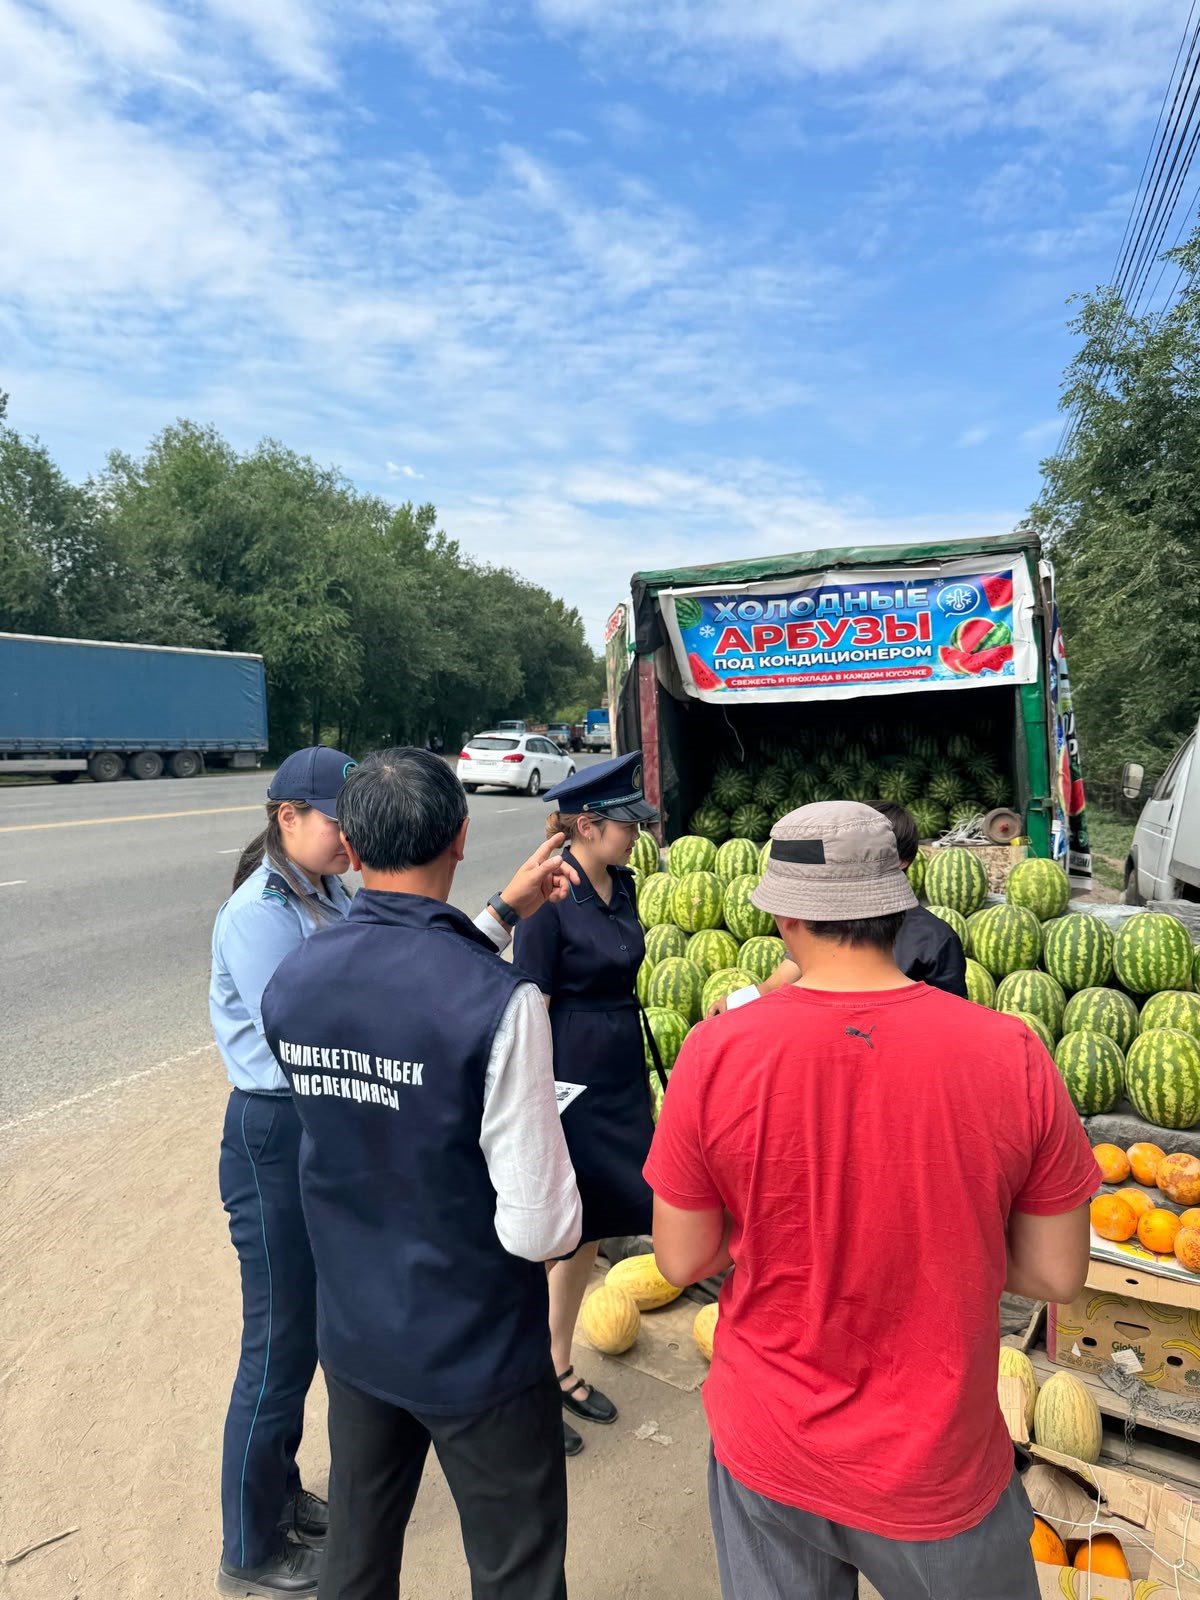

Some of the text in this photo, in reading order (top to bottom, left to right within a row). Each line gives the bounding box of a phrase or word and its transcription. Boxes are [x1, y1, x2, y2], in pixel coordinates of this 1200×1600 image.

[713, 588, 930, 621] ХОЛОДНЫЕ
[713, 611, 932, 655] АРБУЗЫ
[714, 646, 932, 670] ПОД КОНДИЦИОНЕРОМ
[731, 669, 927, 686] СВЕЖЕСТЬ И ПРОХЛАДА В КАЖДОМ КУСОЧКЕ
[375, 1057, 424, 1085] ЕҢБЕК
[292, 1073, 400, 1110] ИНСПЕКЦИЯСЫ
